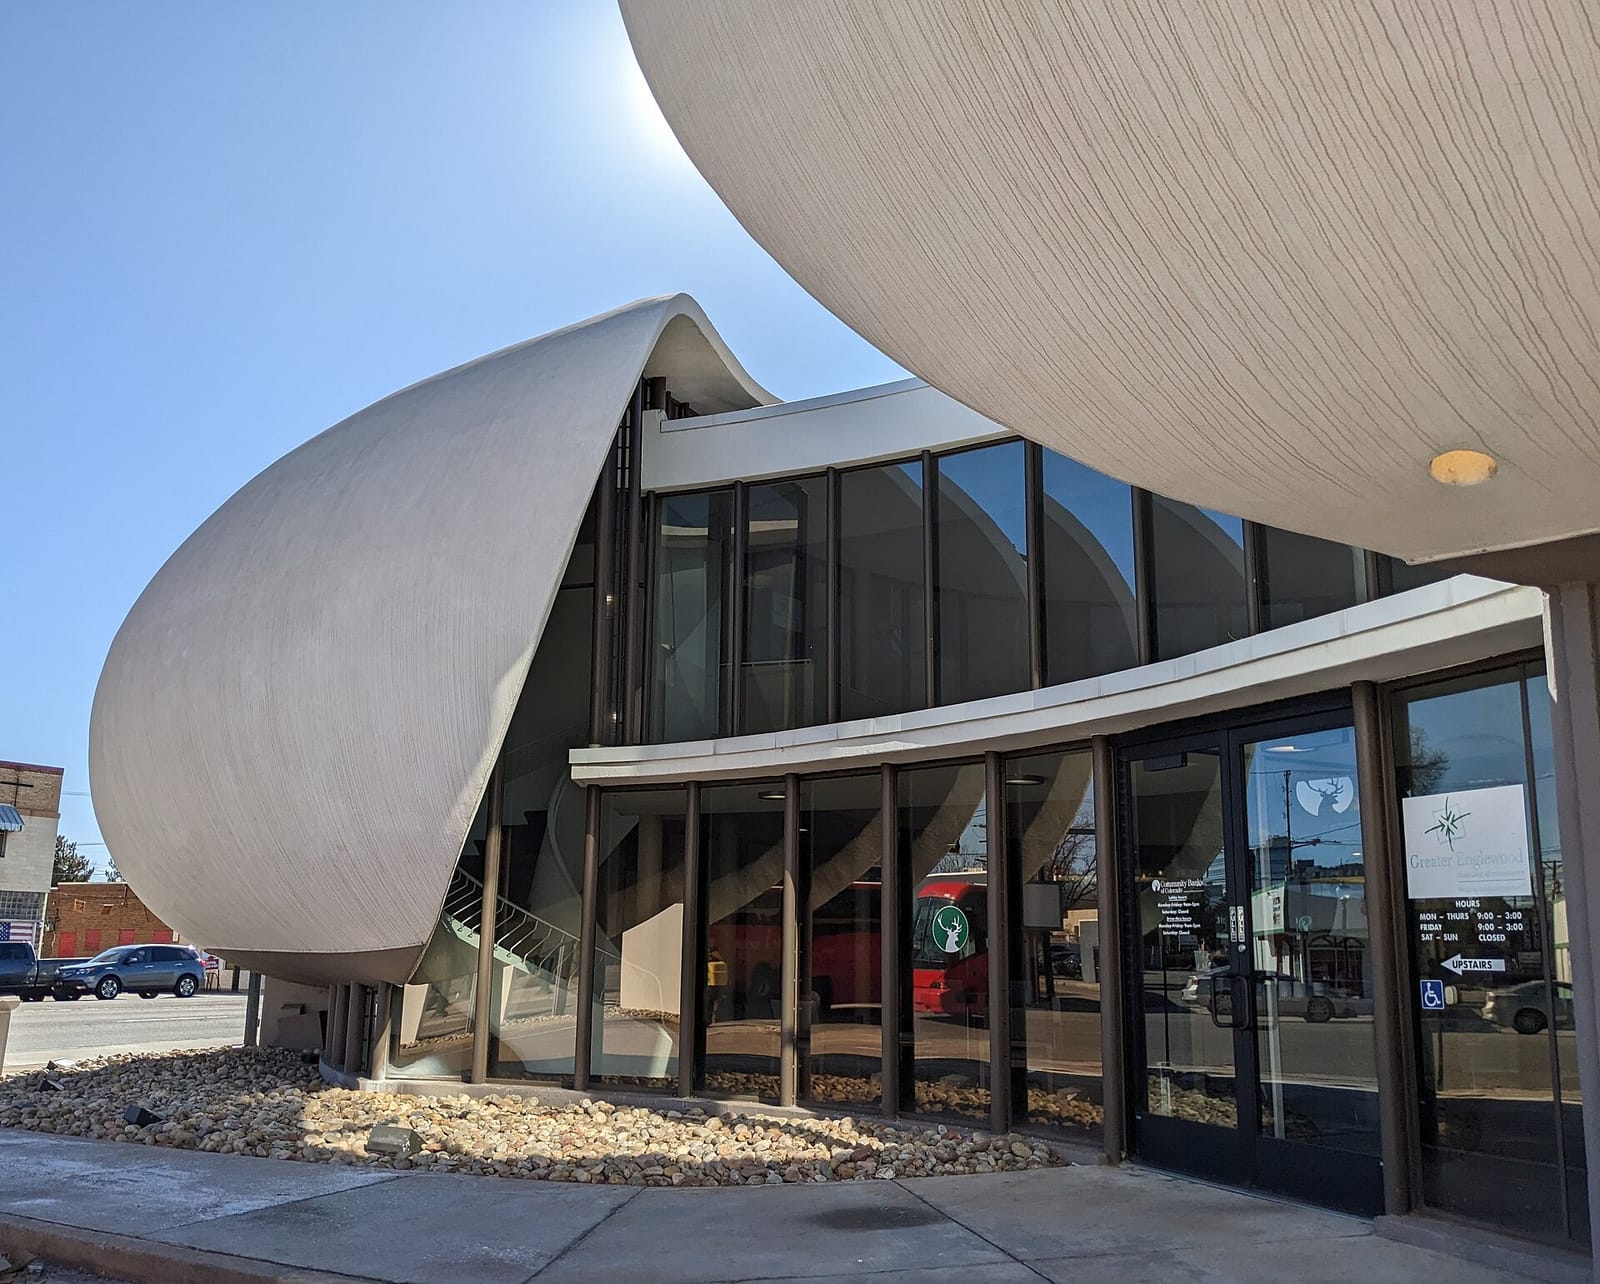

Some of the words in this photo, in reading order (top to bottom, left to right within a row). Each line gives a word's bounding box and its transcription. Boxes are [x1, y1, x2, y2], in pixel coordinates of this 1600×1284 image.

[1410, 854, 1454, 869] Greater
[1456, 848, 1523, 869] Englewood
[1160, 880, 1187, 889] Community
[1455, 900, 1480, 908] HOURS
[1420, 913, 1437, 921] MON
[1447, 912, 1469, 920] THURS
[1477, 912, 1494, 920] 9:00
[1505, 912, 1522, 920] 3:00
[1420, 923, 1442, 931] FRIDAY
[1478, 923, 1495, 931] 9:00
[1506, 923, 1523, 931] 3:00
[1421, 933, 1433, 941] SAT
[1443, 933, 1458, 941] SUN
[1478, 933, 1506, 942] CLOSED
[1452, 960, 1492, 969] UPSTAIRS
